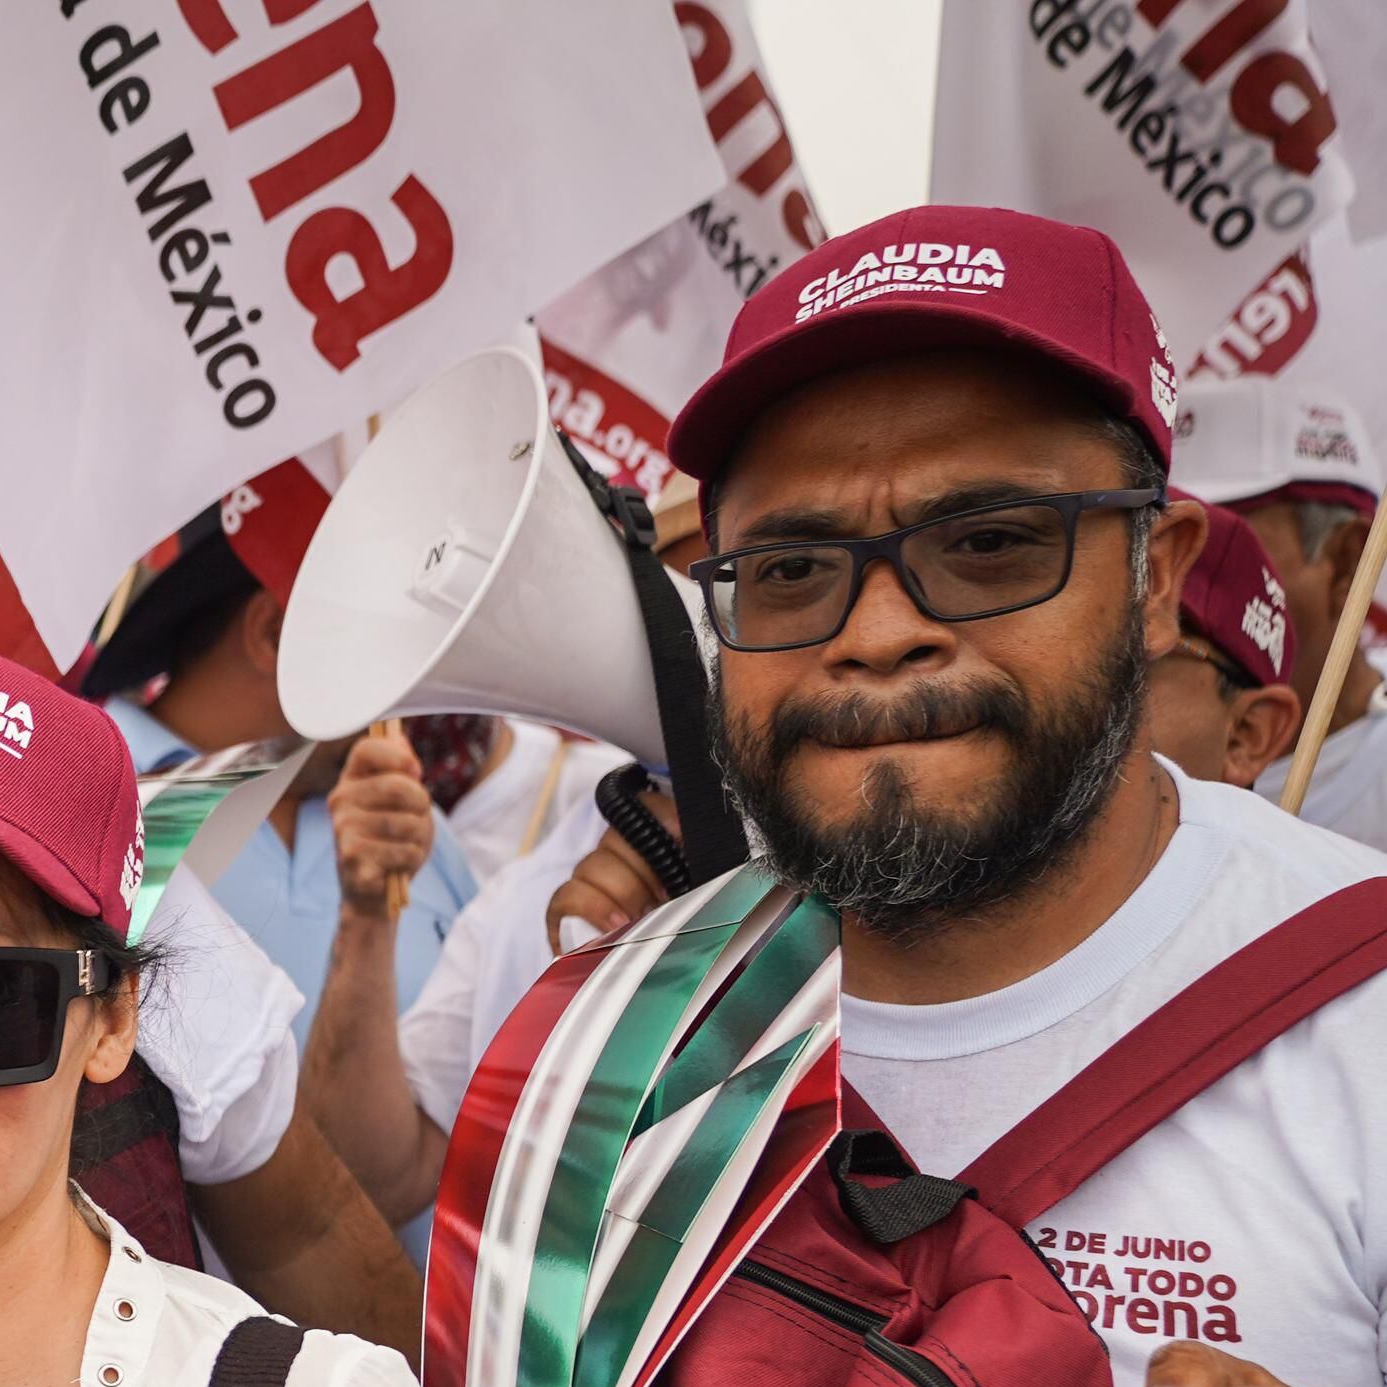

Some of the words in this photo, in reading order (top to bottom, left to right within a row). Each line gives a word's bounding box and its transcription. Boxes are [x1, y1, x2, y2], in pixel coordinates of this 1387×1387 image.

[1082, 45, 1258, 252] México
[79, 22, 160, 135] de
[121, 131, 277, 431] México
[795, 264, 1006, 325] SHEINBAUM
[798, 243, 1006, 305] CLAUDIA
[839, 282, 947, 310] PRESIDENTA
[1037, 1227, 1057, 1249] 2
[1065, 1231, 1107, 1255] DE
[1113, 1235, 1212, 1263] JUNIO
[1124, 1267, 1237, 1302] TODO
